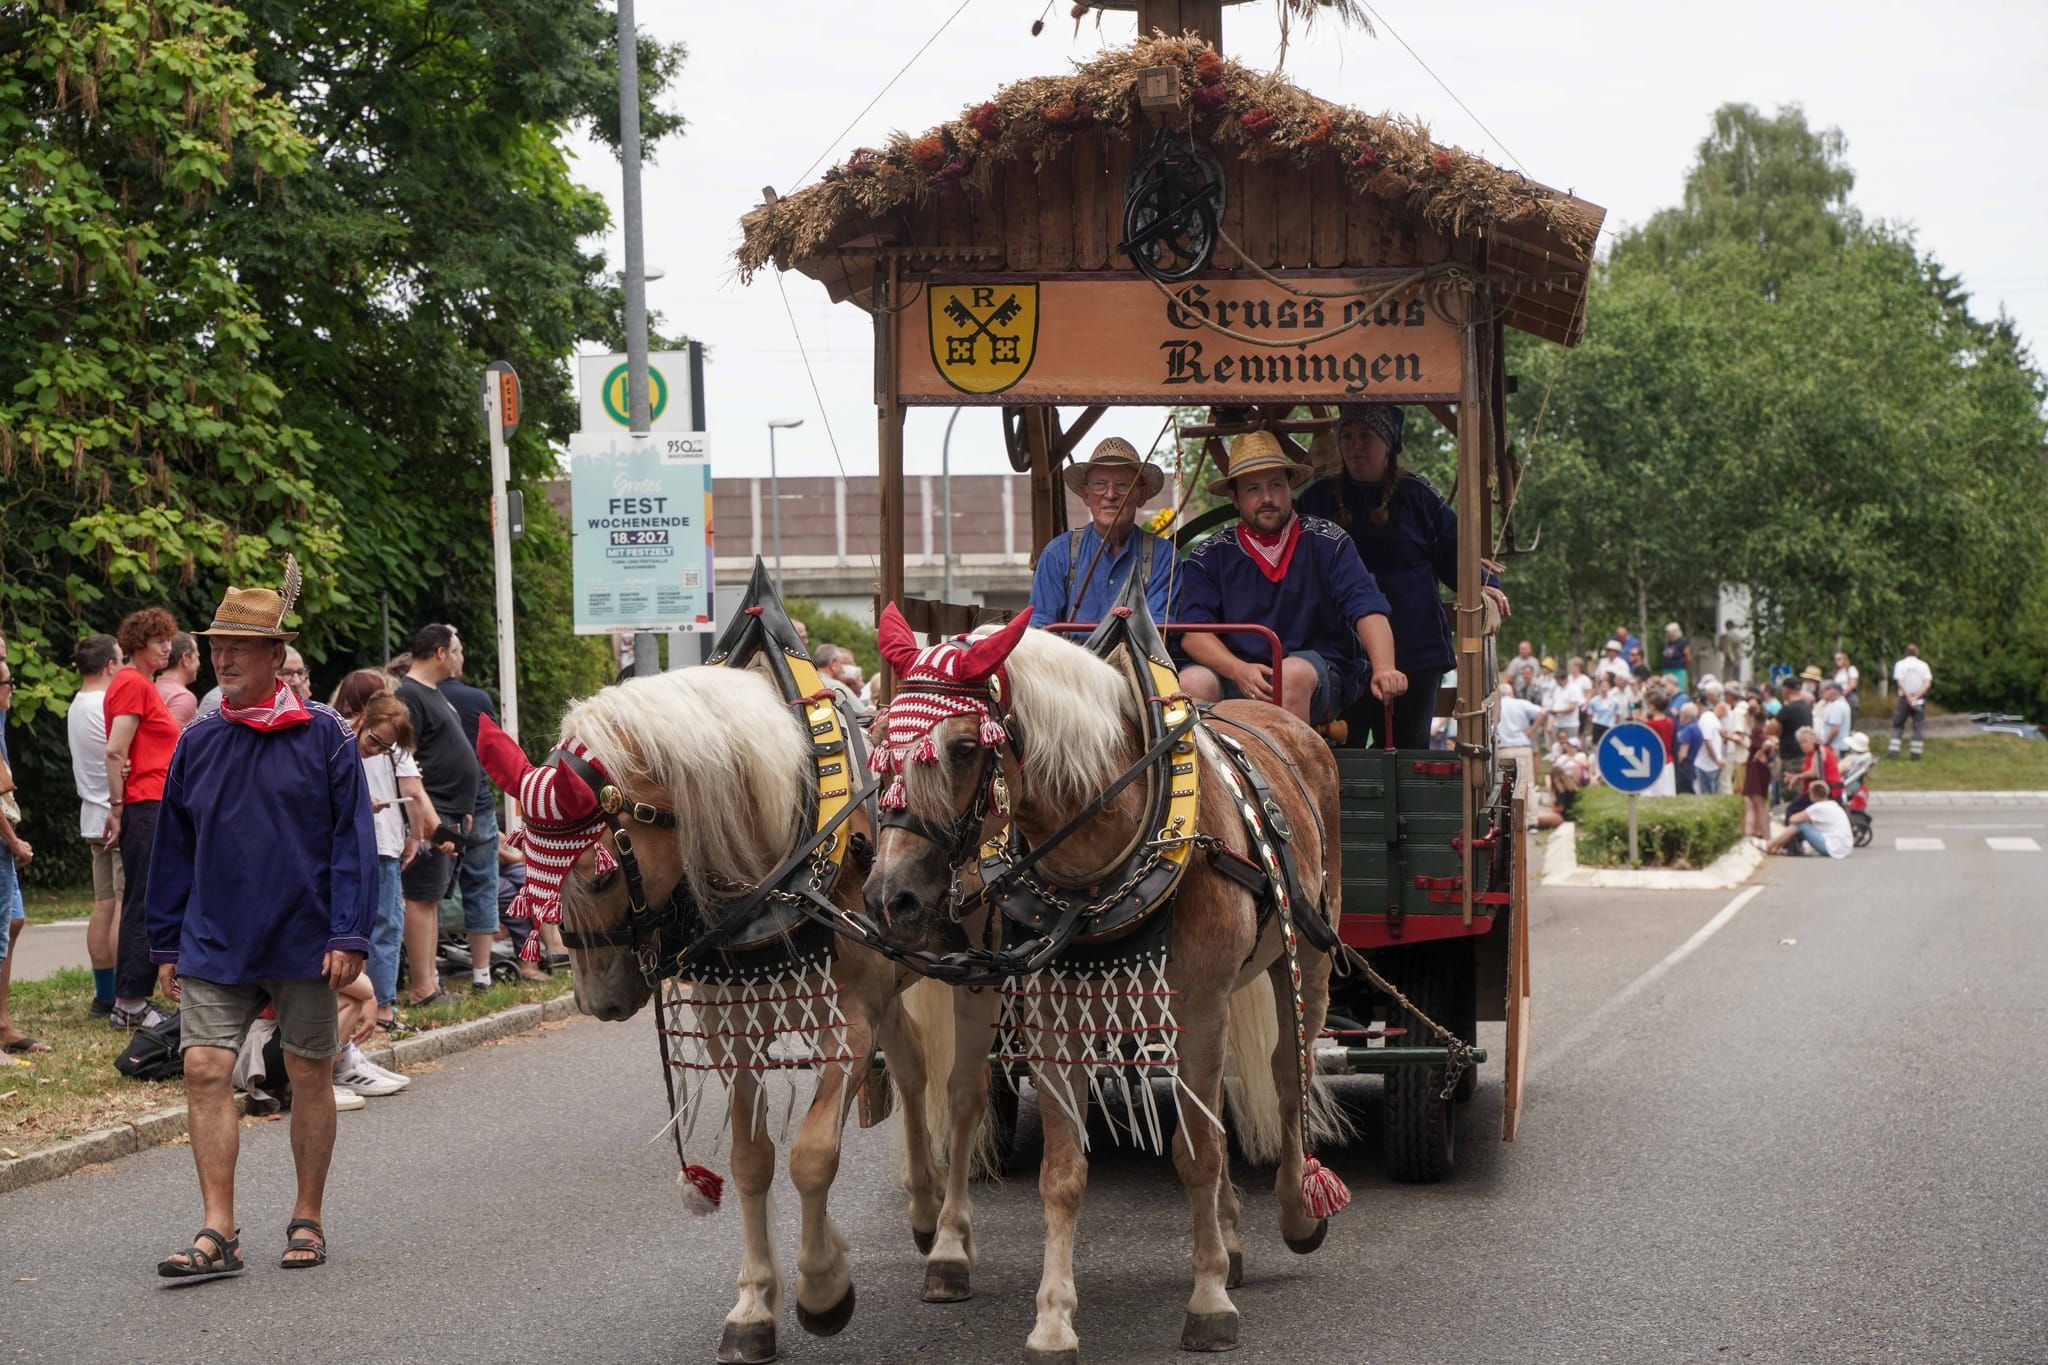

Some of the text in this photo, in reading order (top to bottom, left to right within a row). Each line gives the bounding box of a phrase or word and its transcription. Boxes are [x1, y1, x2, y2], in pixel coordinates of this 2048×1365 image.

[971, 287, 996, 308] R
[1166, 283, 1426, 330] Gruss aus
[1159, 340, 1424, 393] Renningen
[609, 497, 667, 515] FEST
[588, 517, 690, 529] WOCHENENDE
[607, 547, 672, 557] MIT FESTZELT
